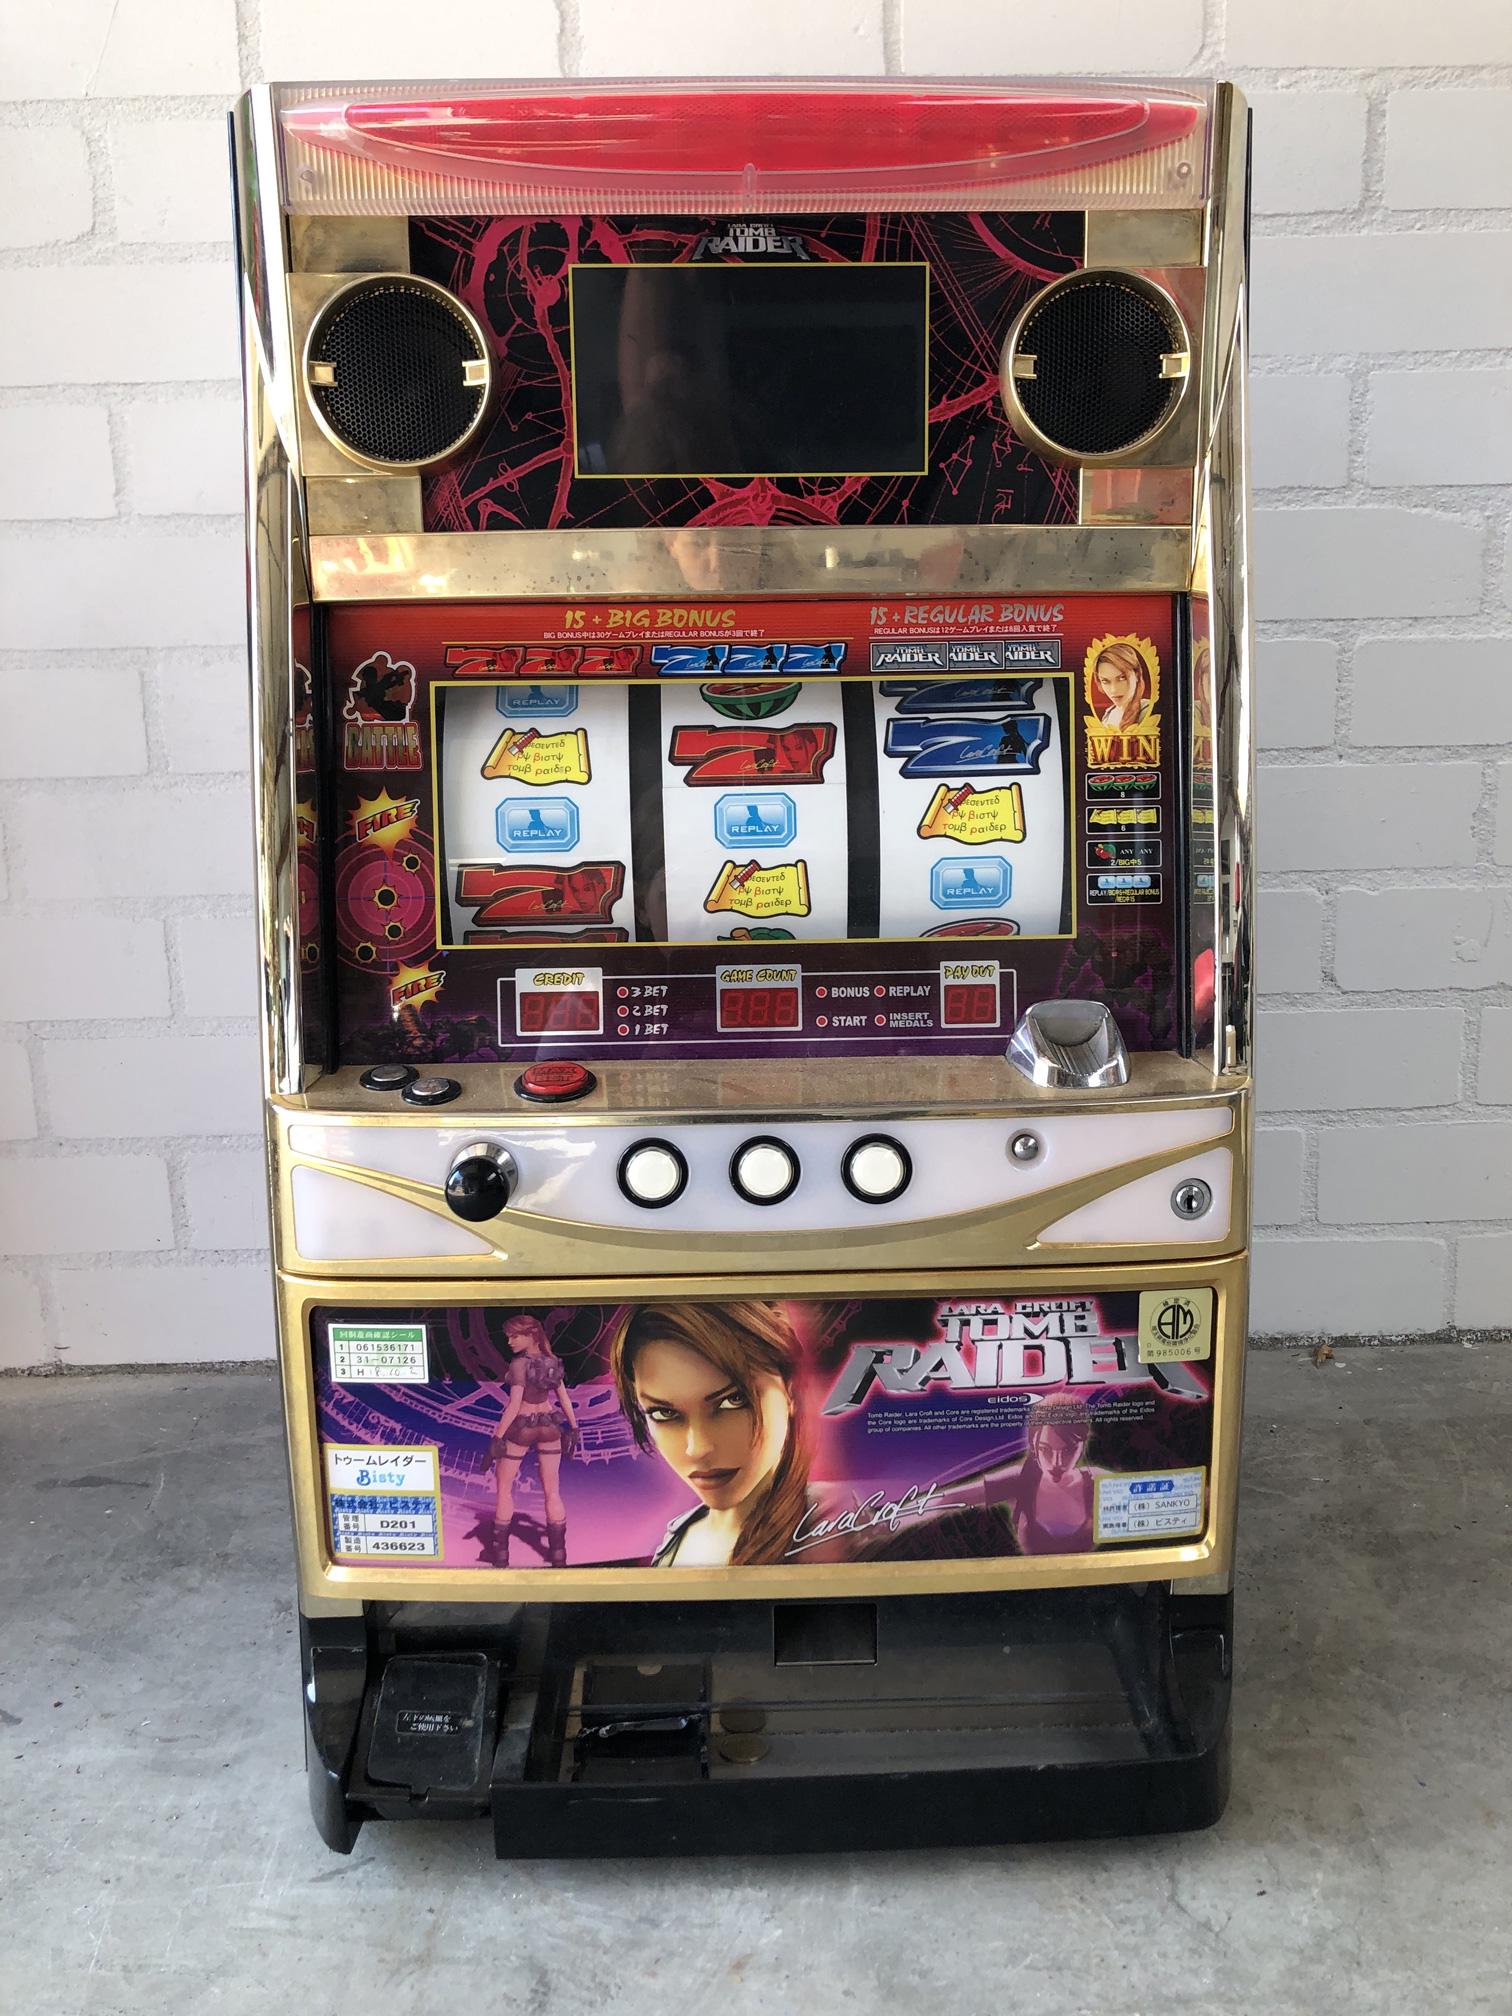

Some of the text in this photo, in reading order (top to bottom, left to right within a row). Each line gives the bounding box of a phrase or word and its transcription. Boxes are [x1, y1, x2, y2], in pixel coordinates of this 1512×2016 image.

[728, 227, 777, 237] TOMB
[692, 235, 810, 261] RAIDER
[605, 609, 650, 628] BIG
[653, 608, 736, 628] BONUS
[904, 604, 995, 625] REGULAR
[998, 603, 1064, 623] BONUS
[874, 627, 908, 635] REGULAR
[876, 650, 1056, 667] RAIDER AIDER AIDER
[512, 698, 562, 706] REPLAY
[1090, 735, 1158, 763] WIN
[356, 799, 420, 842] FIRE
[512, 829, 564, 838] REPLAY
[731, 824, 781, 833] REPLAY
[946, 886, 994, 896] REPLAY
[720, 968, 798, 983] GAME COUNT
[944, 964, 995, 979] PAY OUT
[533, 972, 586, 986] CREDIT
[390, 971, 447, 1007] FIRE
[630, 986, 669, 998] 3 BET
[831, 986, 870, 998] BONUS
[889, 985, 931, 997] REPLAY
[644, 1004, 669, 1016] BET
[890, 1012, 929, 1020] INSERT
[832, 1015, 868, 1027] START
[890, 1020, 934, 1028] MEDALS
[634, 1024, 670, 1035] 1 BET
[941, 1301, 1093, 1315] LARA CROFT
[938, 1311, 1100, 1343] TOMB
[356, 1344, 415, 1352] 061536171
[988, 1396, 1028, 1404] eidos
[335, 1453, 426, 1466] トゥームレイダー
[357, 1470, 405, 1486] Bisty
[1155, 1499, 1190, 1510] SANKYO
[380, 1520, 416, 1529] D201
[1155, 1516, 1188, 1527] ビスティ
[372, 1542, 426, 1552] 436623
